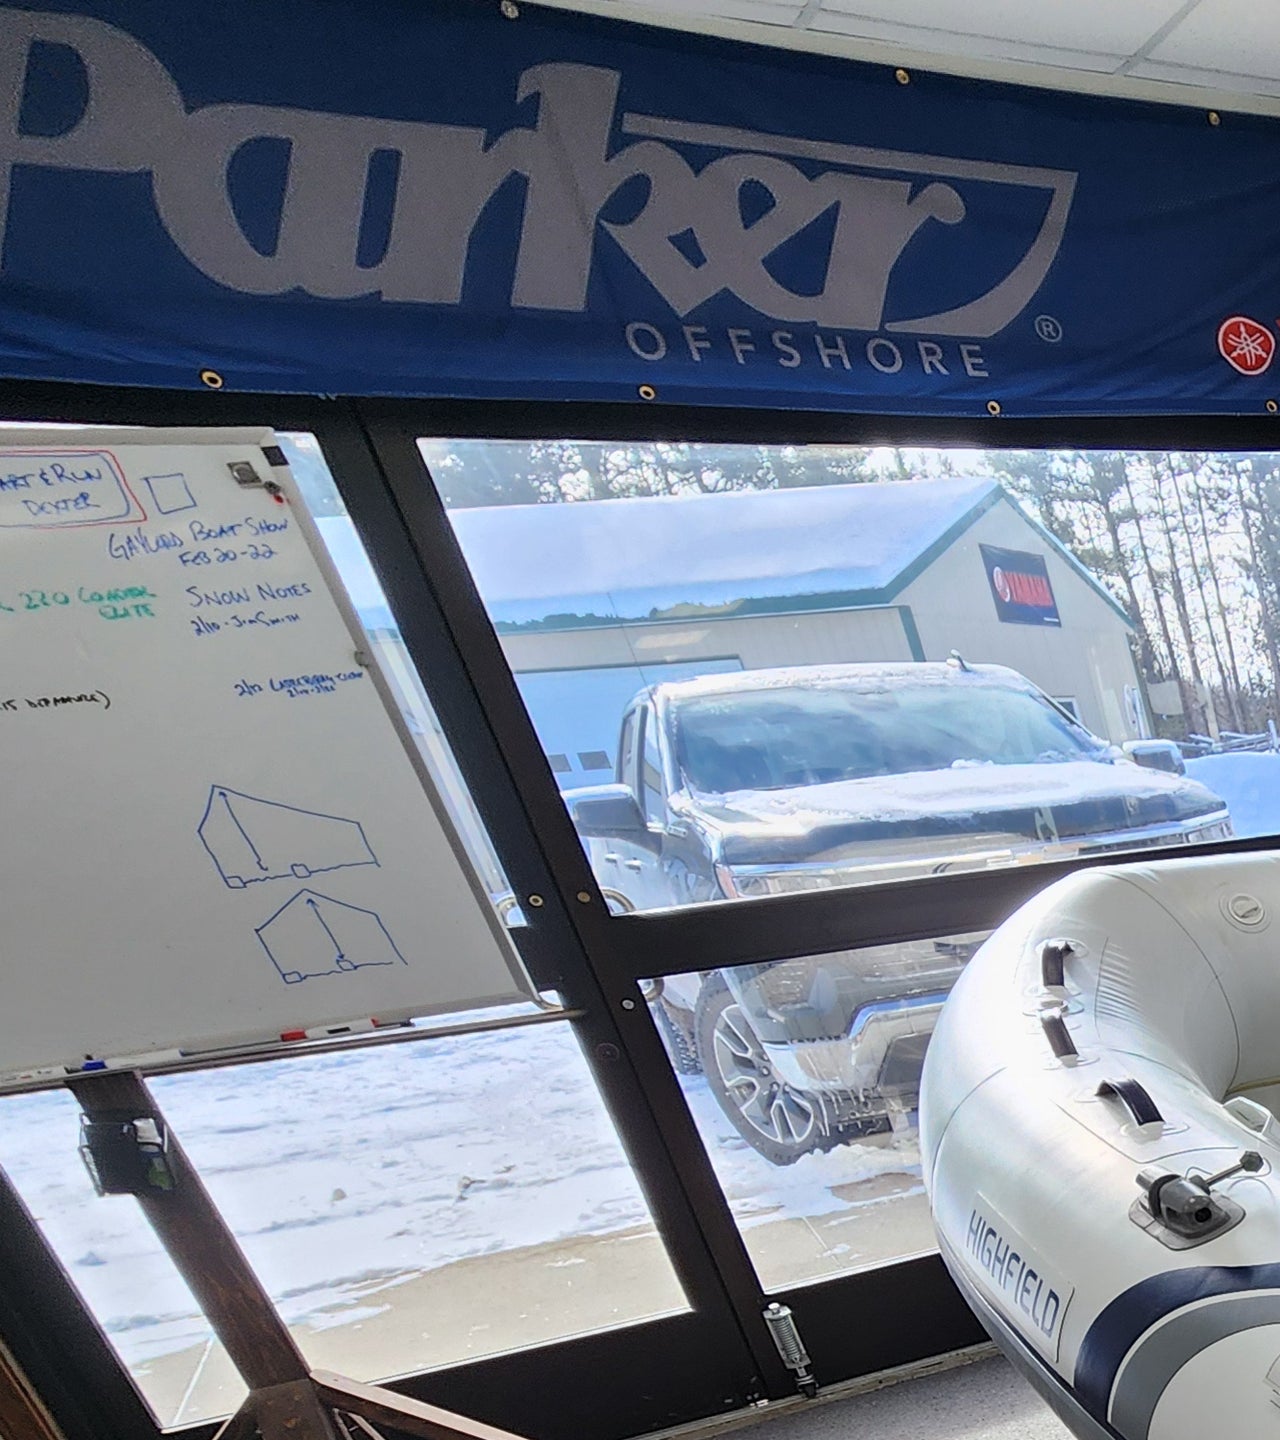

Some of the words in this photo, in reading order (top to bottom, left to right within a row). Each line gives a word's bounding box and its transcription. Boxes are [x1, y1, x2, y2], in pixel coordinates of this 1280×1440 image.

[0, 8, 968, 333] Parker
[625, 322, 989, 377] OFFSHORE
[189, 519, 243, 542] BOAT
[244, 516, 289, 536] SHOW
[178, 551, 212, 567] FEB
[185, 585, 251, 608] SNOW
[256, 582, 313, 601] NOTES
[966, 1208, 1060, 1339] HIGHFIELD
